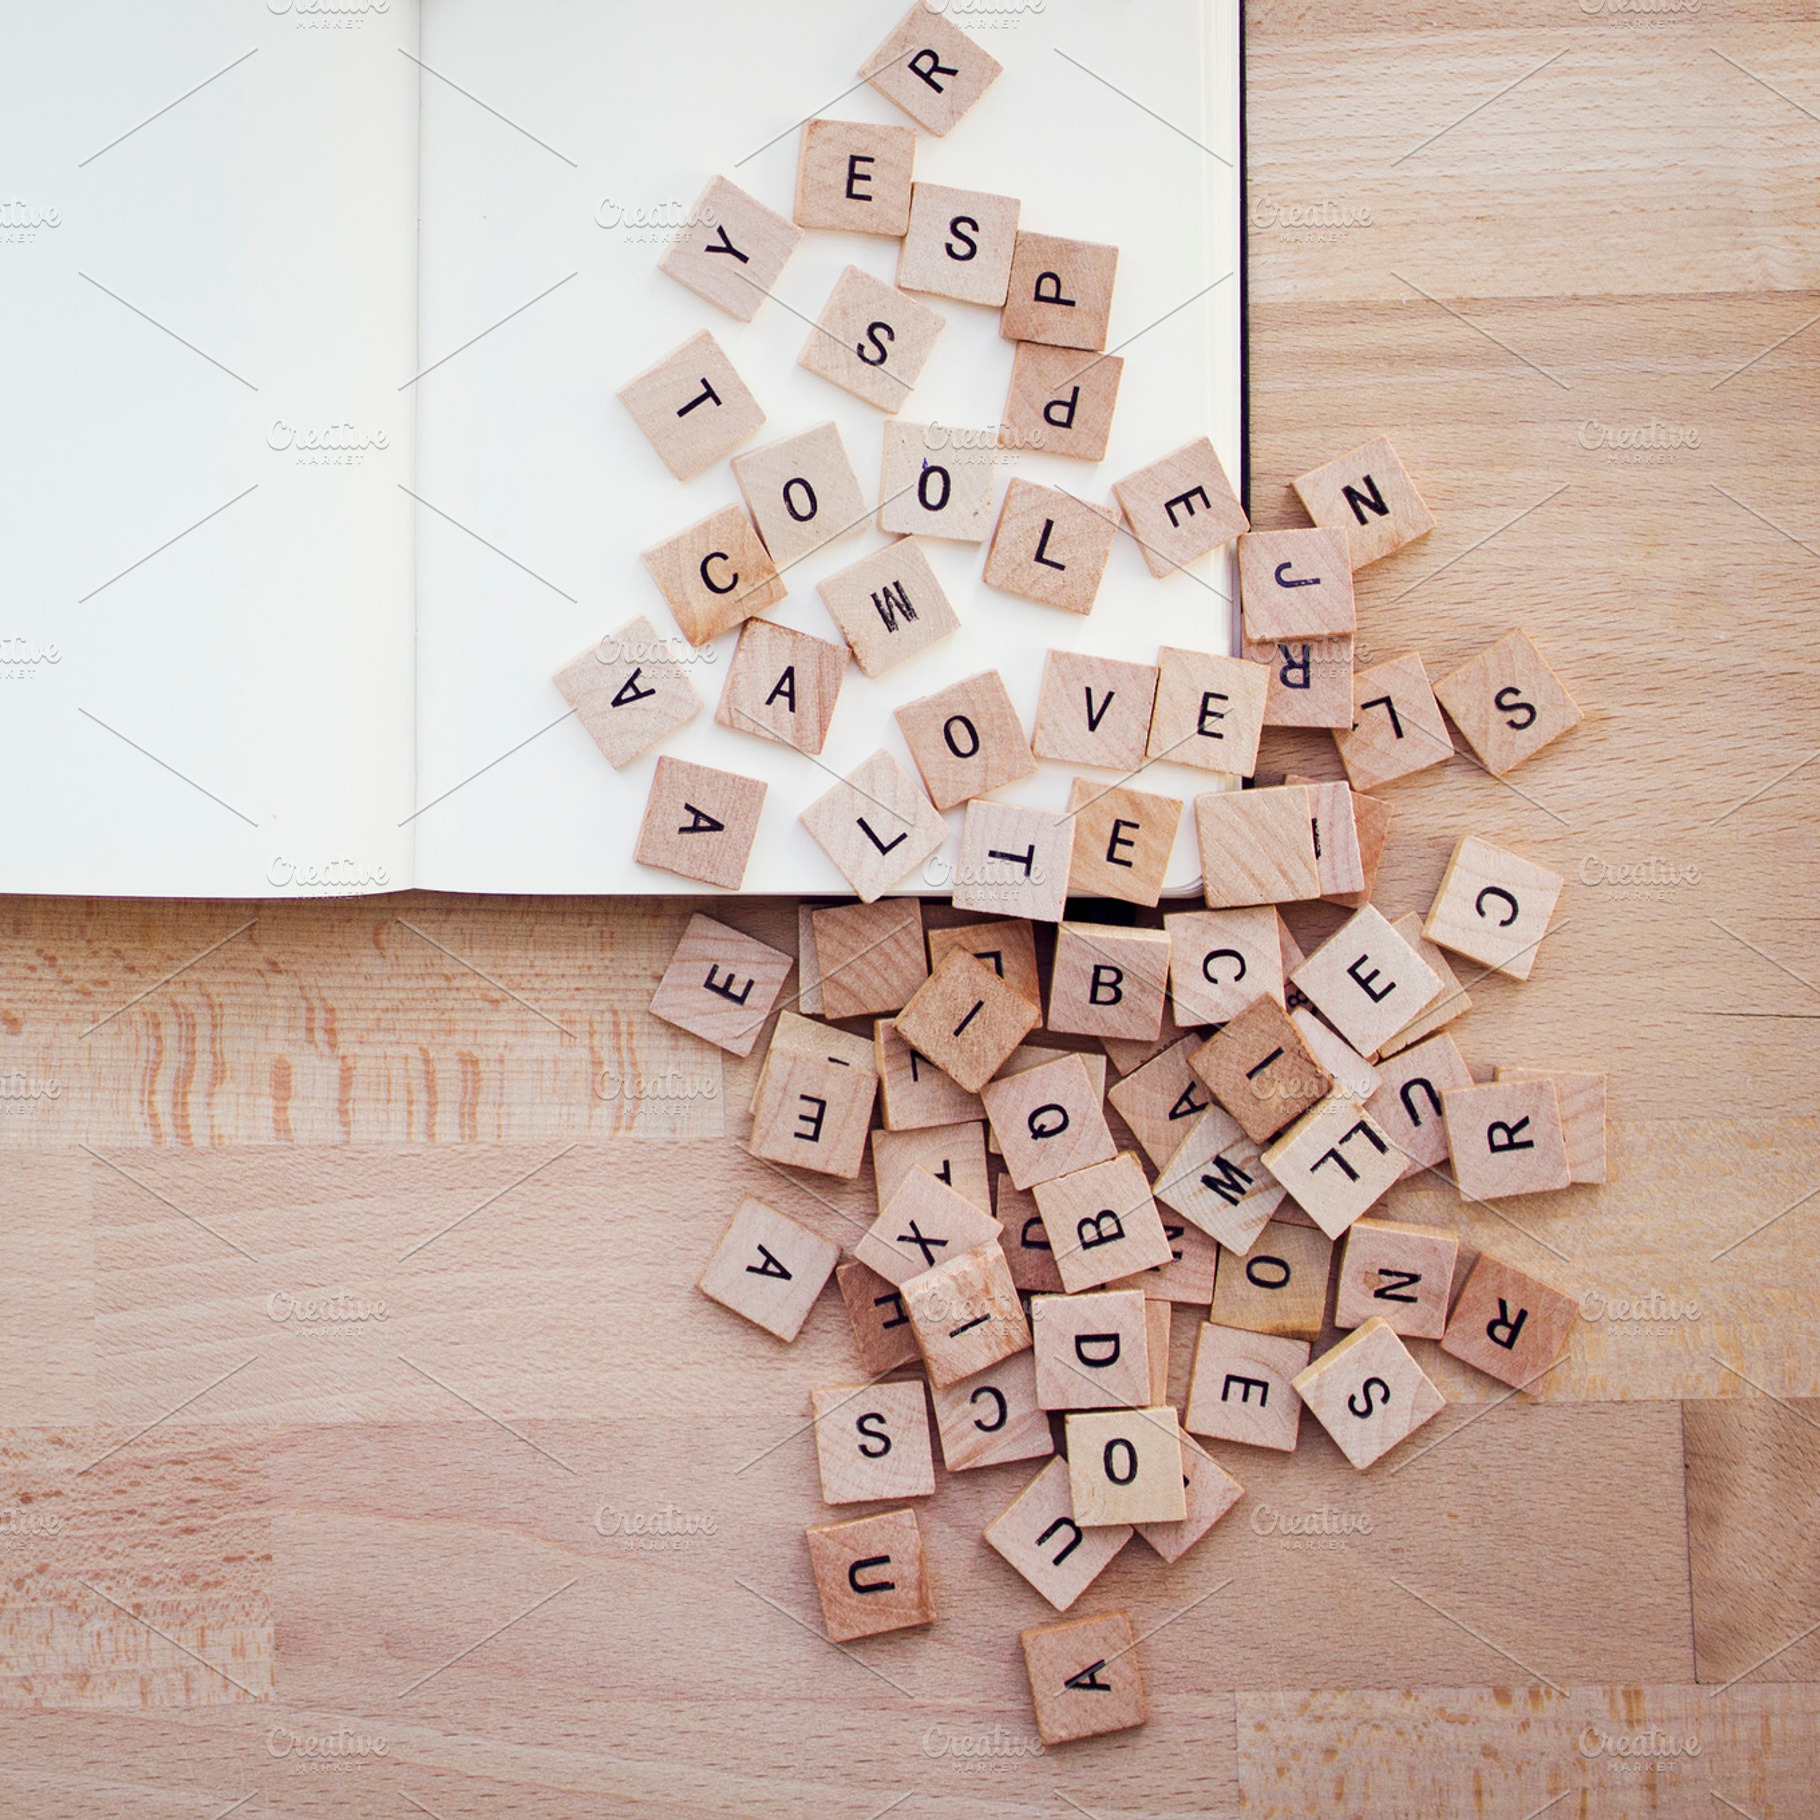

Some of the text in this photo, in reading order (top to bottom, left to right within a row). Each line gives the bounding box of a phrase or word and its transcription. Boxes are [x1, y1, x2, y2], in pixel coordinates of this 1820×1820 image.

[908, 49, 958, 93] R
[846, 155, 874, 201] E
[705, 226, 749, 263] Y
[946, 216, 979, 260] S
[1034, 272, 1075, 307] P
[857, 322, 894, 366] S
[677, 378, 721, 417] T
[1044, 386, 1079, 429] P
[783, 478, 817, 521] O
[917, 465, 951, 511] O
[1165, 486, 1211, 527] E
[1342, 475, 1389, 525] N
[1034, 519, 1065, 570] L
[700, 552, 738, 594] C
[1275, 562, 1320, 588] J
[611, 668, 655, 707] A
[1278, 644, 1310, 689] R
[766, 666, 795, 712] A
[1086, 687, 1114, 732] V
[1495, 687, 1536, 730] S
[944, 715, 979, 758] O
[1197, 692, 1228, 739] E
[1361, 696, 1403, 739] L
[679, 803, 724, 834] A
[857, 818, 907, 855] L
[989, 845, 1034, 877] T
[1107, 819, 1139, 867] E
[1476, 887, 1518, 926] C
[704, 964, 754, 1005] E
[1089, 965, 1123, 1005] B
[1203, 949, 1246, 984] C
[1347, 954, 1396, 1003] E
[953, 1000, 984, 1037] I
[1246, 1047, 1284, 1080] I
[794, 1095, 826, 1142] E
[1169, 1081, 1211, 1120] A
[1400, 1078, 1443, 1127] U
[1028, 1104, 1069, 1140] Q
[1488, 1116, 1534, 1153] R
[897, 1220, 948, 1267] X
[1077, 1210, 1125, 1250] B
[746, 1245, 792, 1280] A
[1246, 1255, 1291, 1289] O
[1374, 1269, 1421, 1303] N
[949, 1314, 990, 1338] I
[1486, 1297, 1528, 1350] R
[1075, 1333, 1120, 1368] D
[971, 1386, 1007, 1432] C
[1222, 1375, 1269, 1407] E
[1348, 1377, 1390, 1419] S
[856, 1413, 891, 1458] S
[1104, 1439, 1137, 1485] O
[1035, 1517, 1083, 1566] U
[848, 1555, 895, 1594] U
[1064, 1660, 1111, 1691] A
